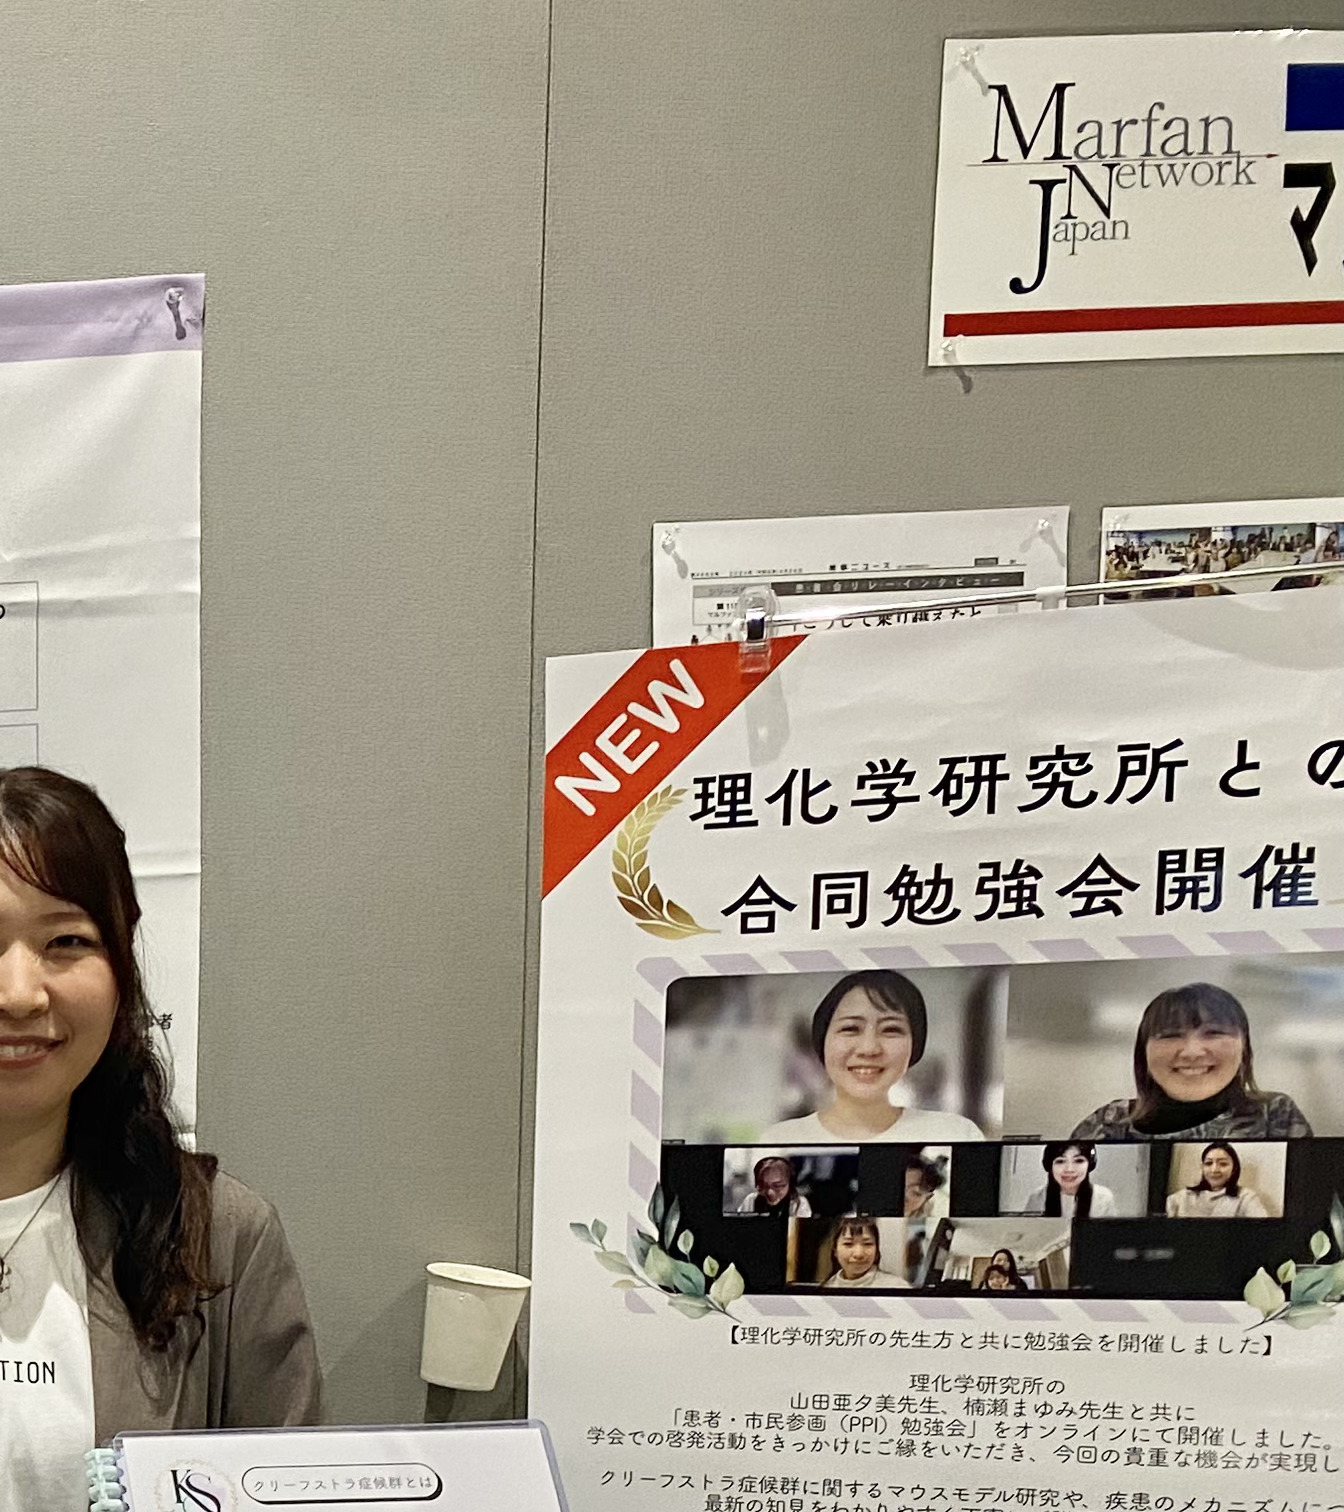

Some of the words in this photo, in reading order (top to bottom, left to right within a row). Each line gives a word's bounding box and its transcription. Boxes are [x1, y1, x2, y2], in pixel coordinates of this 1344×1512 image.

[982, 82, 1240, 163] Marfan
[1061, 151, 1256, 220] Network
[1283, 162, 1336, 277] マ
[1009, 179, 1131, 294] Japan
[554, 659, 706, 815] NEW
[689, 737, 1344, 831] 理化学研究所との
[721, 841, 1321, 935] 合同勉強会開催
[909, 1373, 1066, 1395] 理化学研究所の
[253, 1475, 433, 1493] クリーフストラ症候群とは
